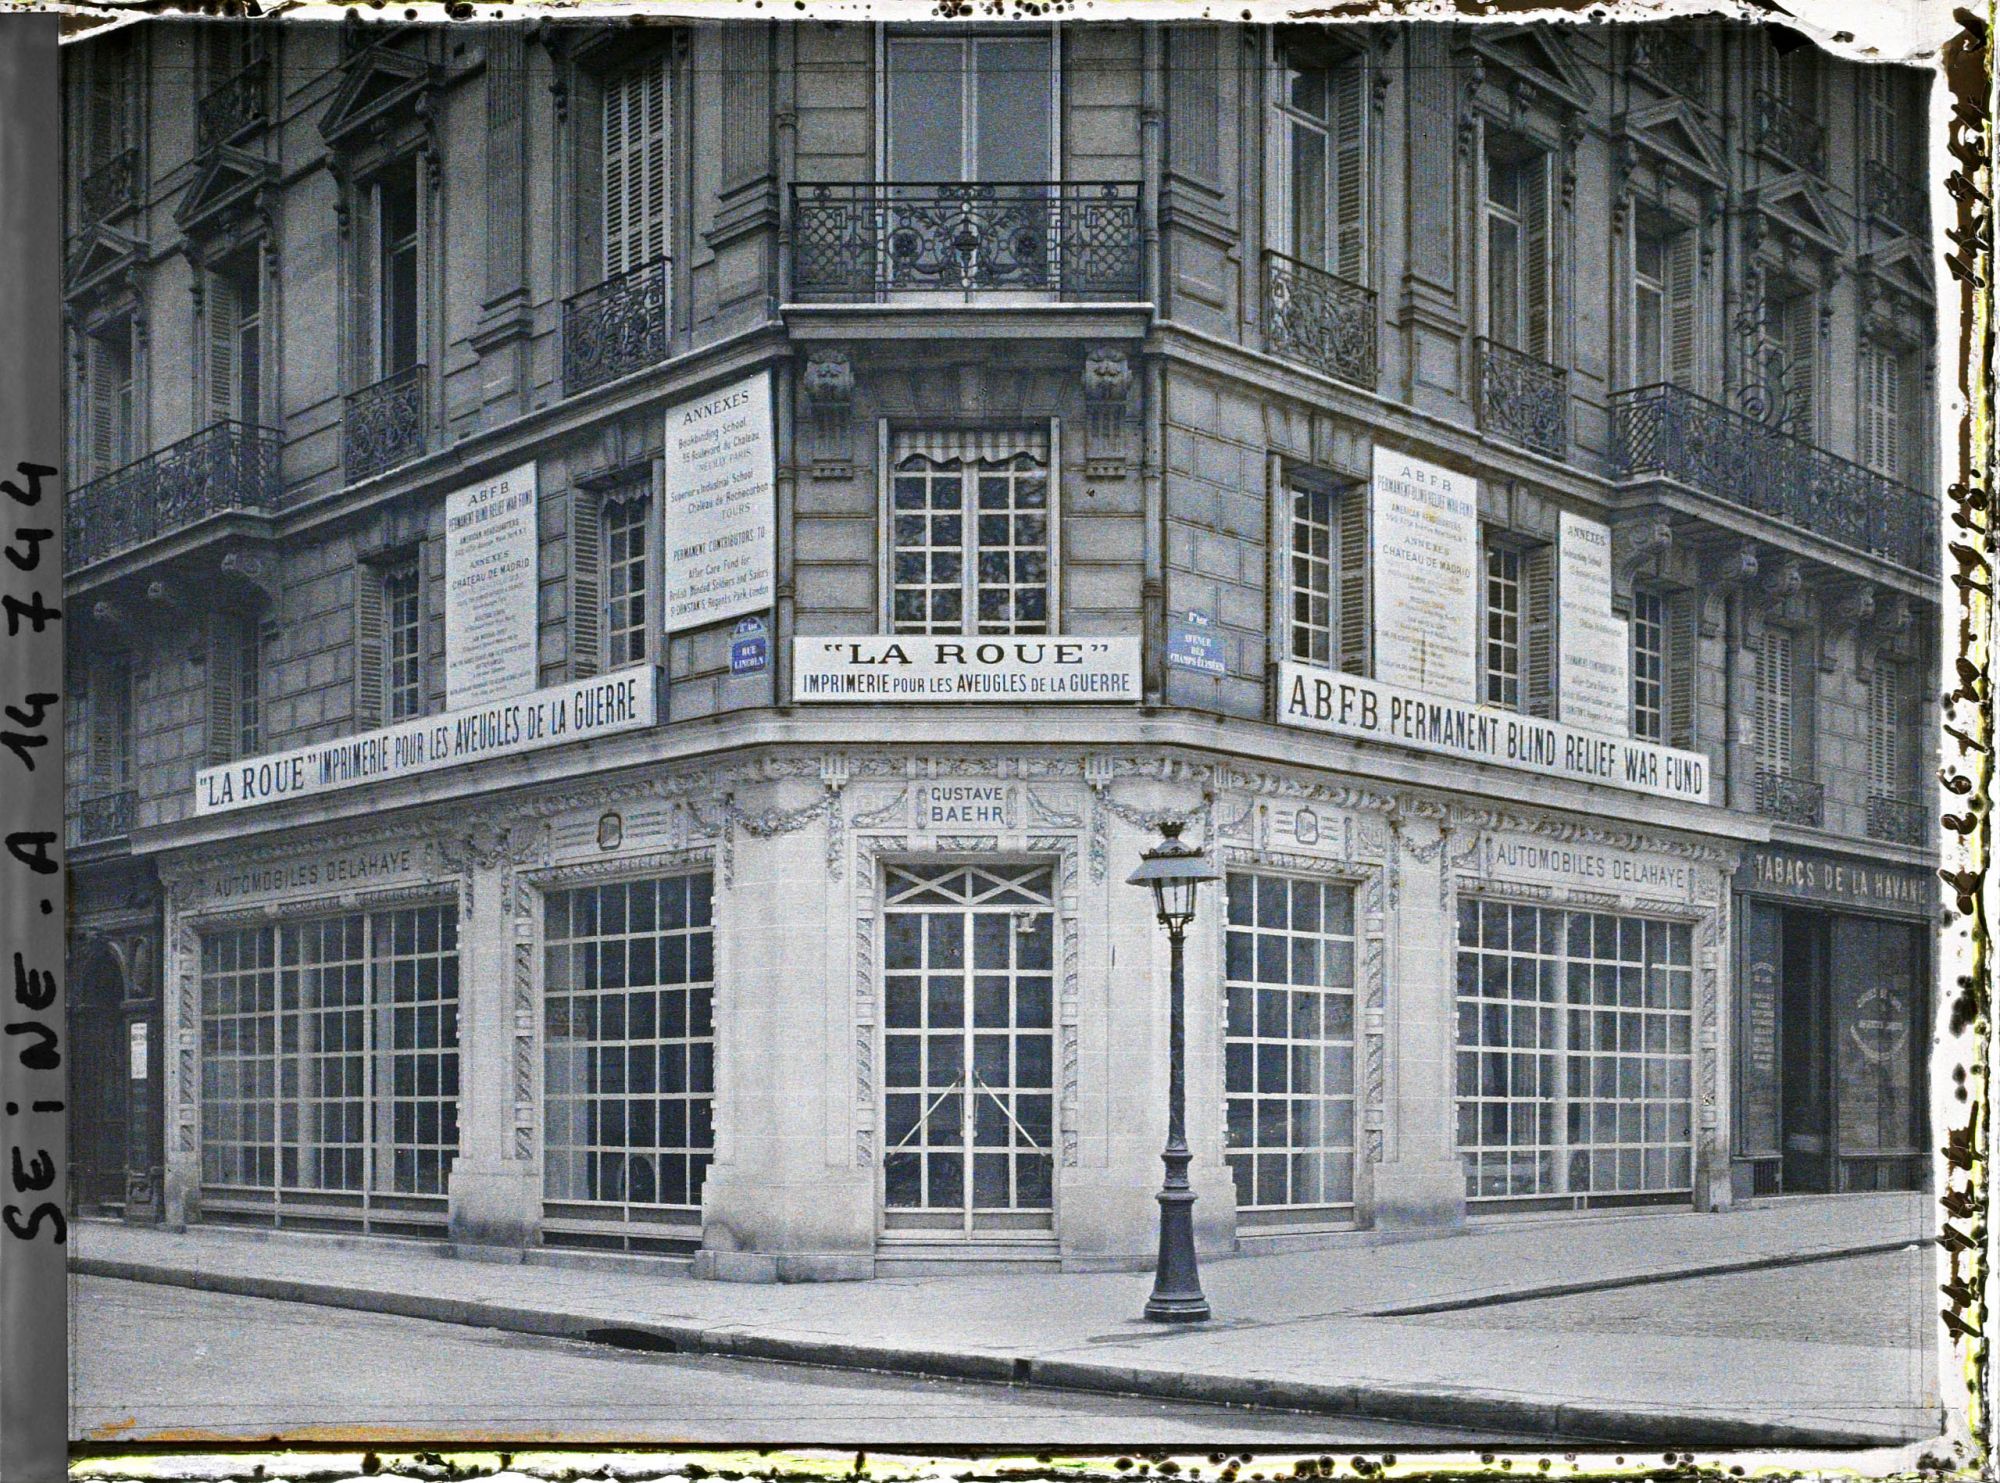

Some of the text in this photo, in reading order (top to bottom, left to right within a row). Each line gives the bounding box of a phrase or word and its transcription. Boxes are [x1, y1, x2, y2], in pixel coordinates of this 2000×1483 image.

[683, 390, 749, 425] ANNEXES
[722, 417, 747, 434] School
[732, 468, 753, 484] School
[722, 502, 751, 519] TOURS
[673, 526, 765, 561] PERMANENT CONTRIBUTORS TO
[1404, 536, 1450, 556] ANNEXES
[706, 564, 720, 575] Care
[724, 558, 738, 570] Fund
[1382, 544, 1424, 565] CHATEAU
[1426, 557, 1437, 569] DE
[1440, 560, 1471, 578] MADRID
[452, 573, 486, 590] CHATEAU
[488, 567, 497, 578] DE
[500, 557, 530, 573] MADRID
[737, 573, 747, 584] and
[741, 644, 757, 657] RUE
[735, 656, 764, 669] LINCOLN
[803, 673, 1130, 693] IMPRIMERIE POUR LES AVEUGLES DE LA GUERRE
[319, 736, 388, 785] IMPRIMERIE
[395, 733, 424, 770] POUR
[430, 726, 449, 760] LES
[455, 706, 520, 756] AVEUGLES
[528, 706, 544, 739] DE
[551, 698, 567, 735] LA
[574, 678, 637, 730] GUERRE
[1391, 696, 1499, 756] PERMANENT
[1508, 723, 1556, 767] BLIND
[1566, 734, 1616, 778] RELIEF
[1624, 746, 1658, 786] WAR
[1667, 756, 1702, 795] FUND
[931, 787, 1003, 801] GUSTAVE
[931, 806, 1003, 824] BAEHR
[214, 849, 410, 898] AUTOMOBILES DELAHAYE
[1496, 844, 1684, 889] AUTOMOBILES DELAHAYE
[1755, 854, 1815, 887] TABACS
[1824, 863, 1844, 892] DE
[1852, 870, 1868, 895] LA
